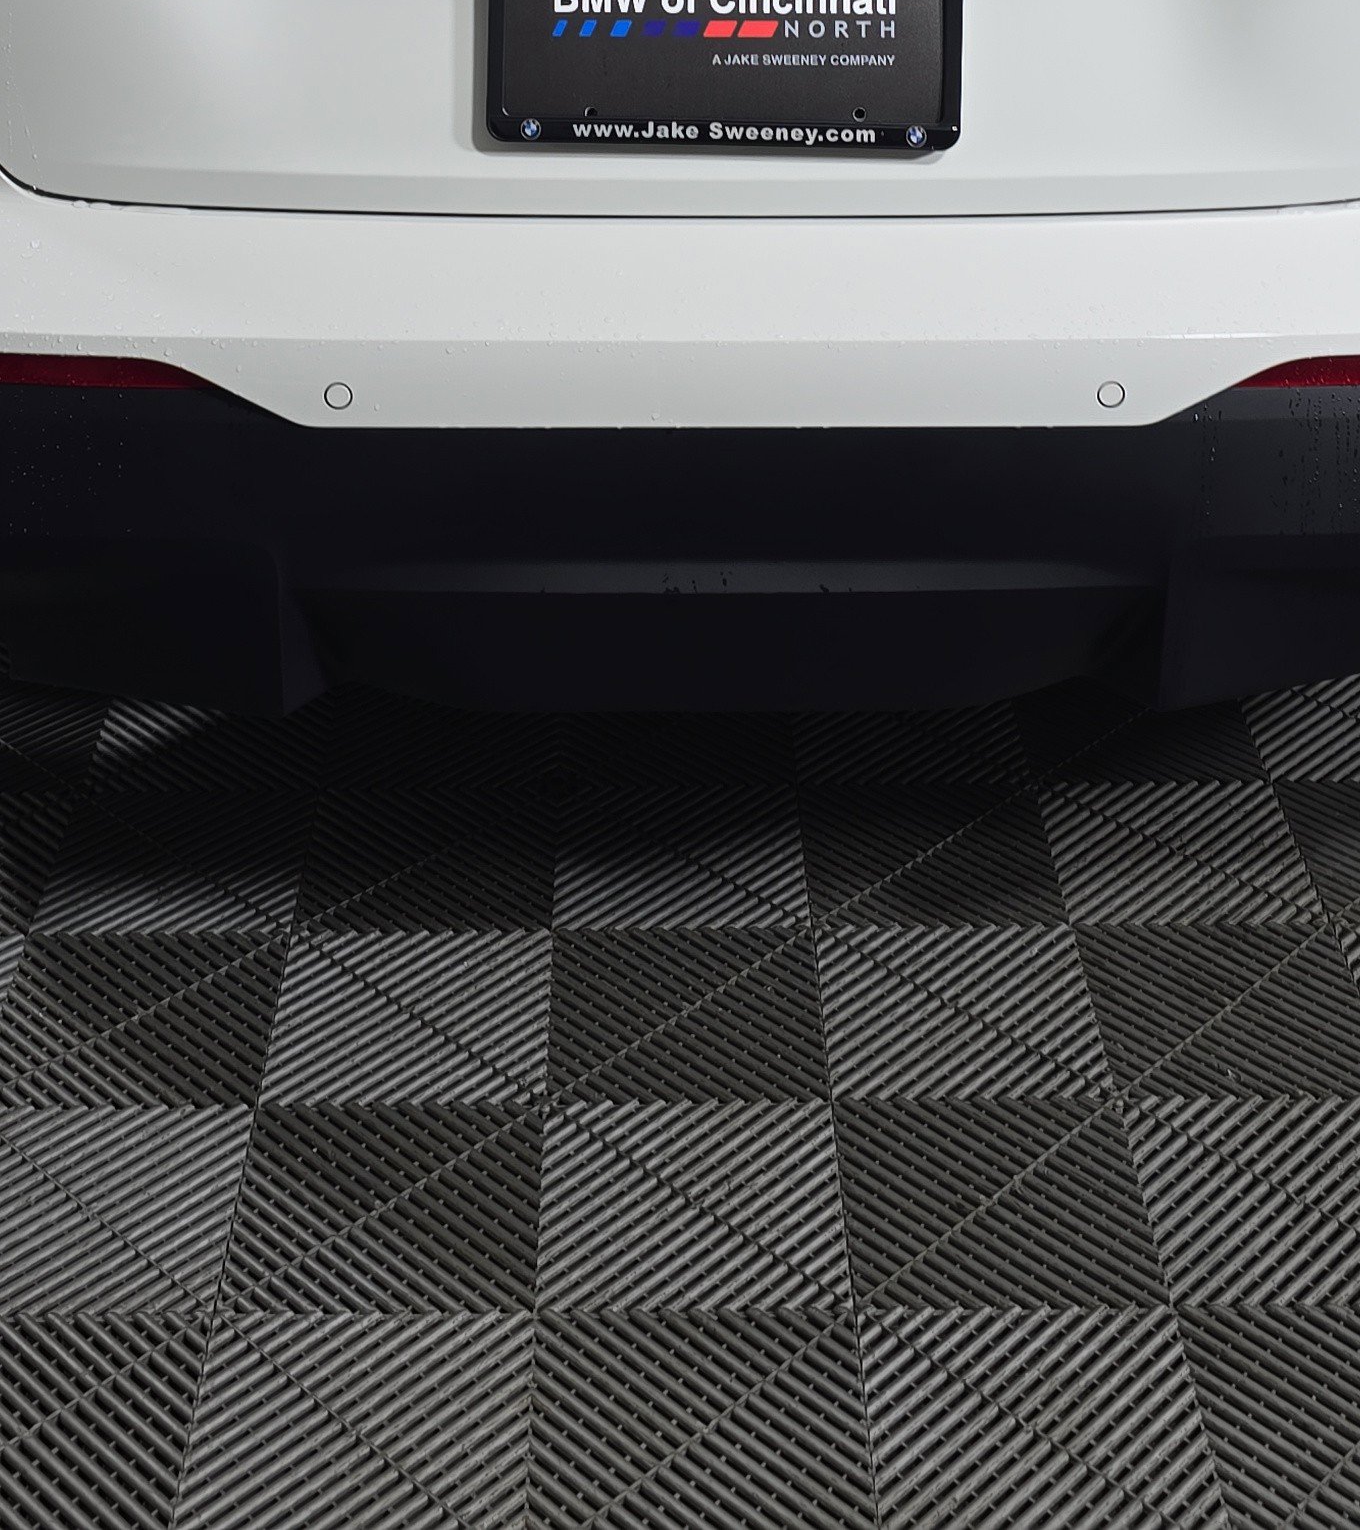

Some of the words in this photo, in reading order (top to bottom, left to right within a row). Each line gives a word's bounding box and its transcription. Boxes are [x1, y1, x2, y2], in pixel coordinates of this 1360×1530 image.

[784, 19, 896, 39] NORTH
[712, 54, 722, 66] A
[724, 54, 759, 66] JAKE
[763, 54, 827, 66] SWEENEY
[830, 54, 896, 66] COMPANY
[572, 121, 700, 140] www.Jake
[708, 122, 877, 146] Sweeney.com
